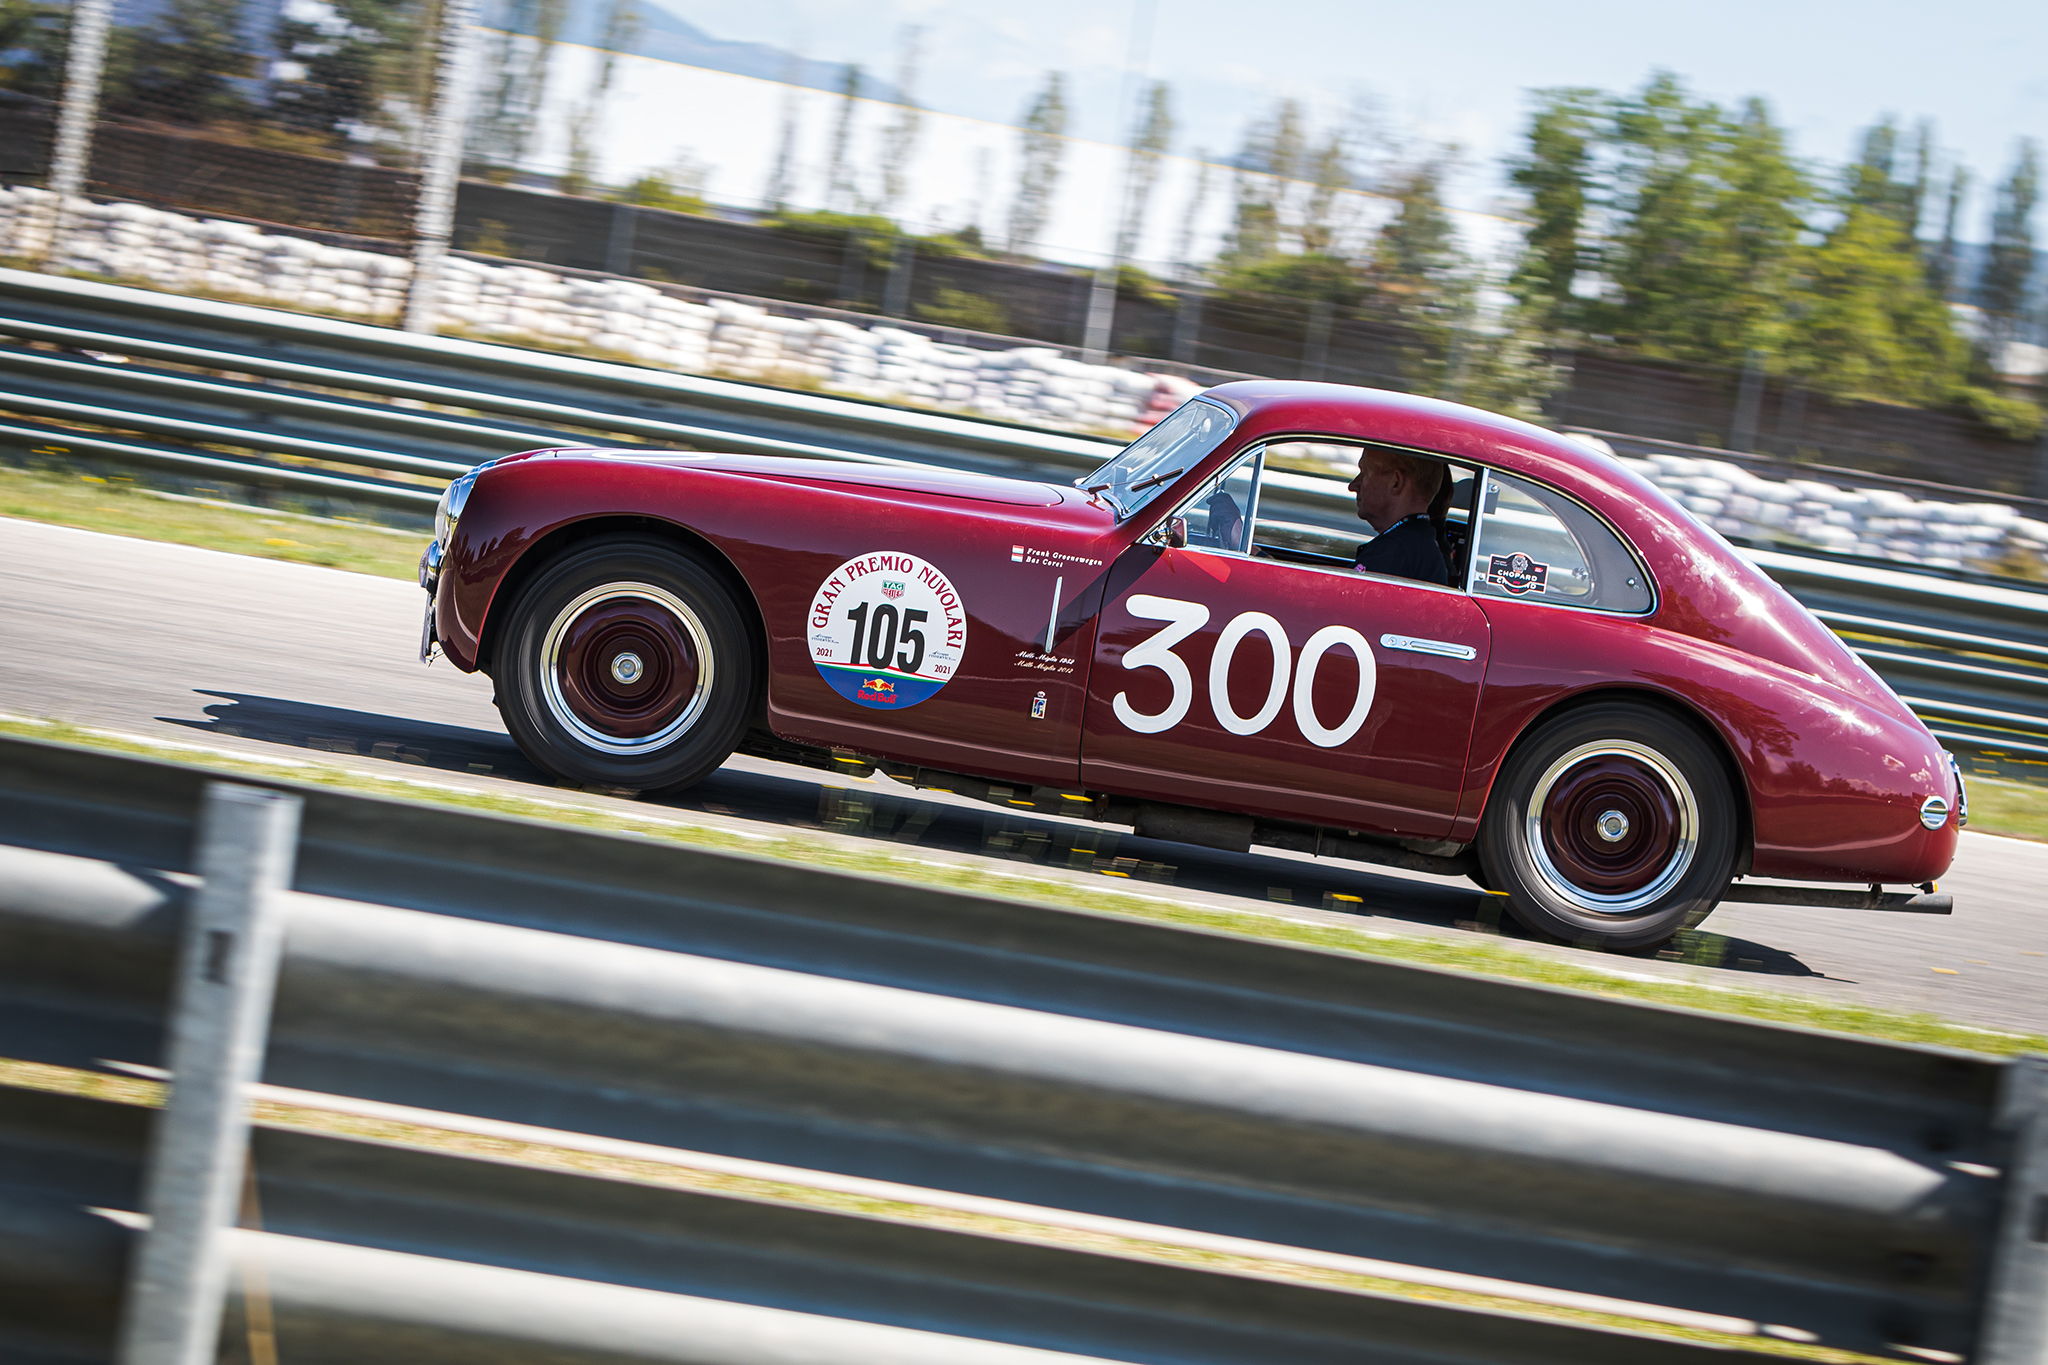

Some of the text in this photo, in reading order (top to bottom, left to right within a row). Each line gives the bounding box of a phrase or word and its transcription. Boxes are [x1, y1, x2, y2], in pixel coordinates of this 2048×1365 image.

[1026, 548, 1050, 557] Frank
[1497, 569, 1538, 582] CHOPARD
[812, 555, 963, 650] GRAN PREMIO NUVOLARI
[847, 602, 928, 674] 105
[816, 647, 833, 657] 2021
[934, 664, 951, 674] 2021
[1112, 594, 1376, 748] 300
[858, 690, 896, 704] Red Bull
